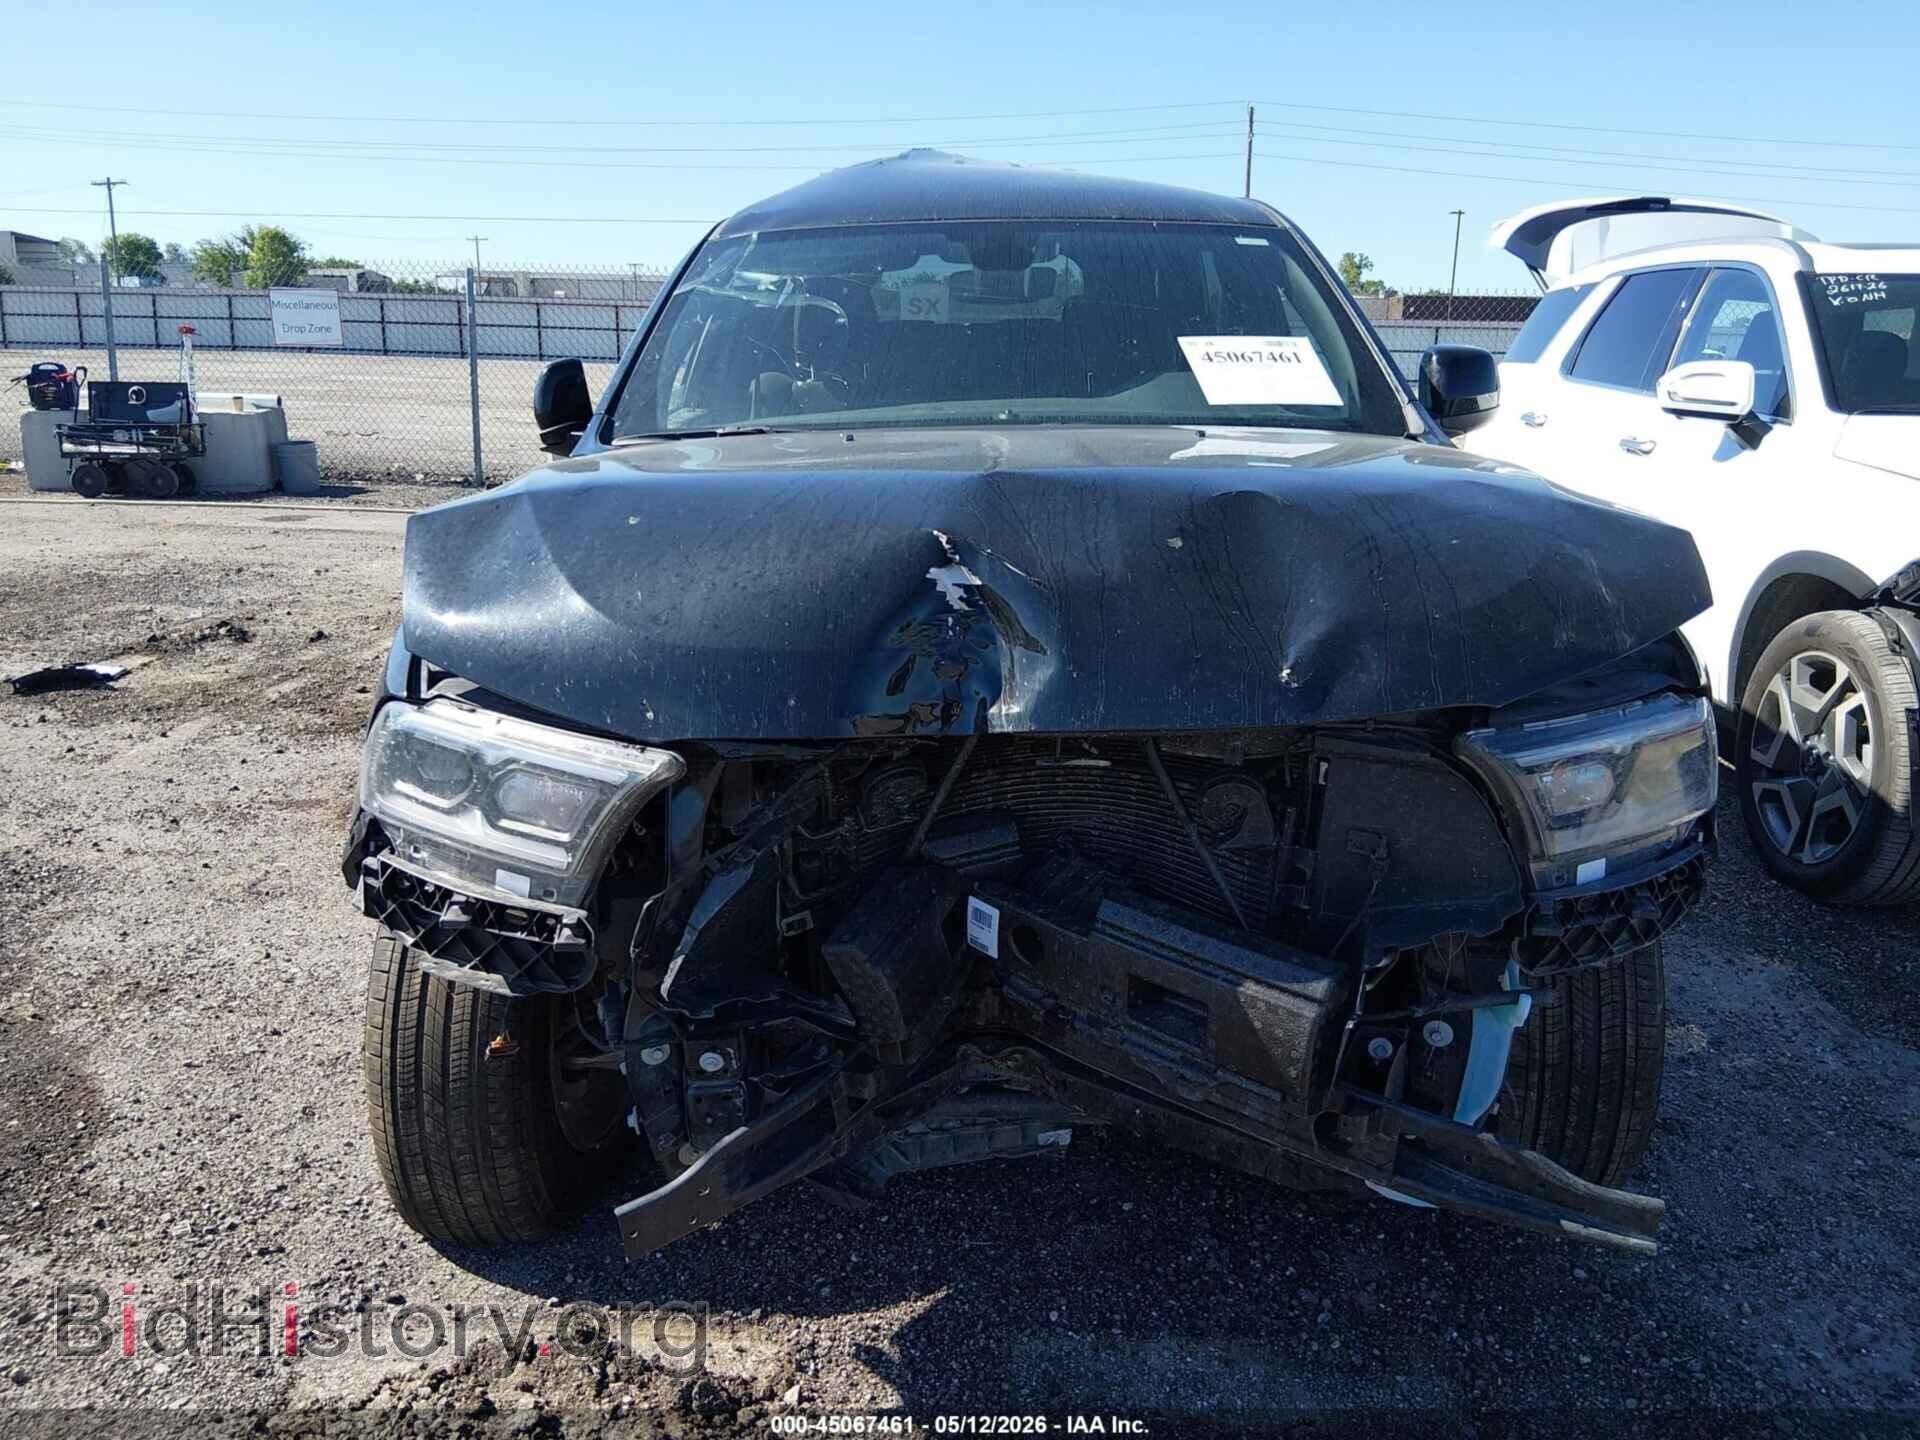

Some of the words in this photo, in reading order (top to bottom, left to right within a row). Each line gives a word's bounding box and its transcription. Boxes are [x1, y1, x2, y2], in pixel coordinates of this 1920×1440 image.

[271, 300, 338, 310] Miscellaneous
[281, 323, 306, 335] Drop
[307, 323, 333, 333] Zone
[1201, 351, 1303, 364] 45067461
